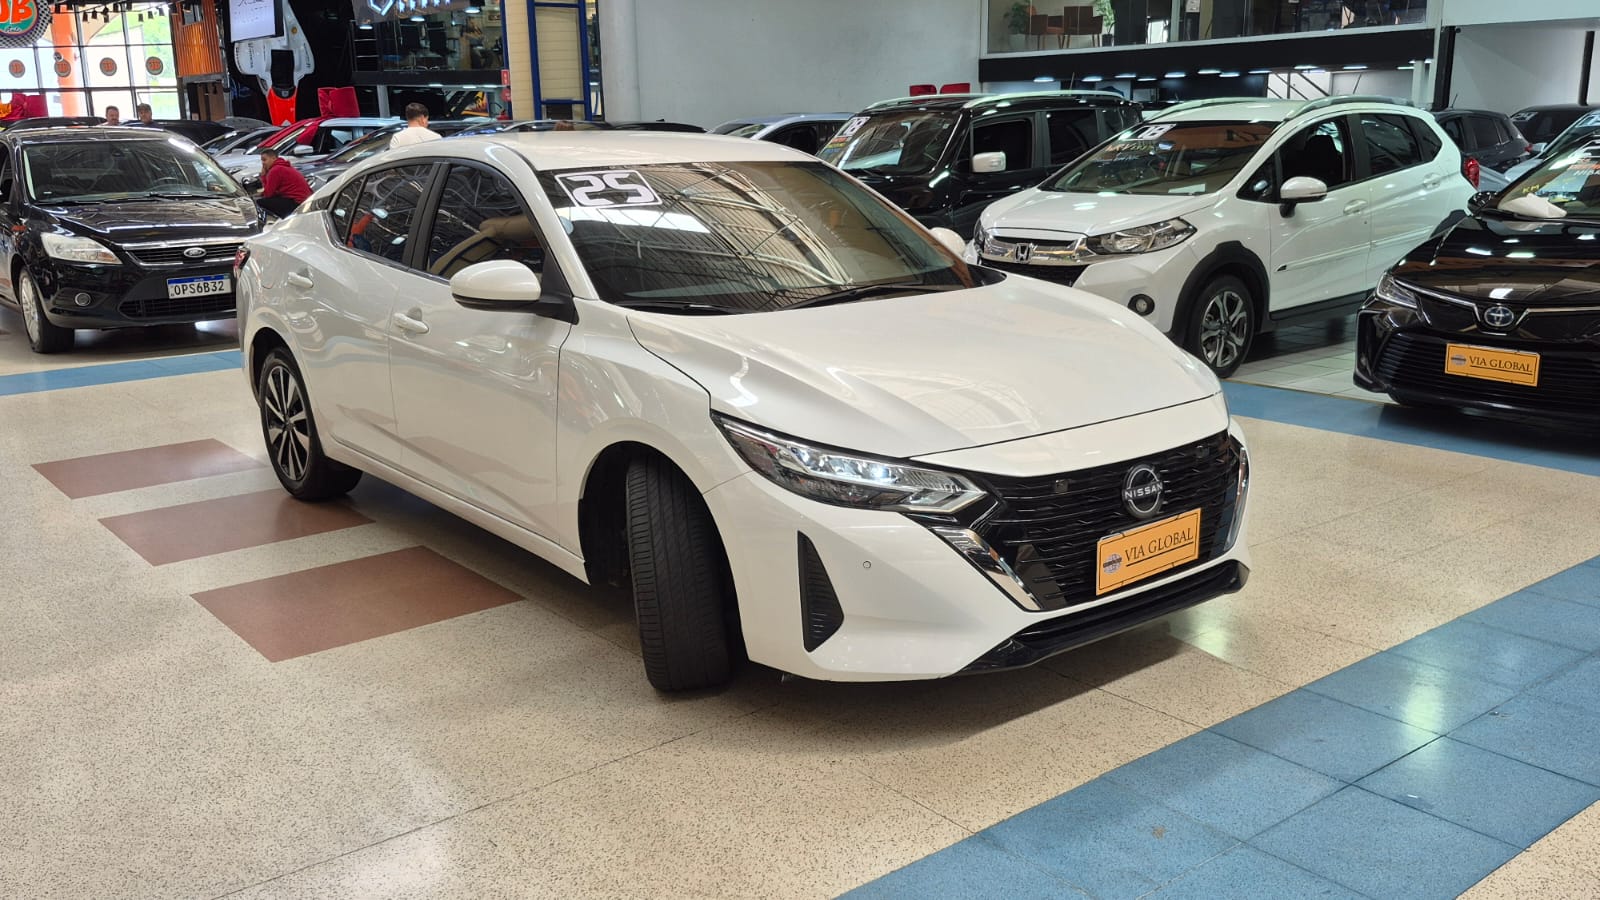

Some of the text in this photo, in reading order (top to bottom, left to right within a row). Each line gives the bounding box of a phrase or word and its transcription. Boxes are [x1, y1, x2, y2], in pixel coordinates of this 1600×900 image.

[566, 173, 655, 206] 25
[1469, 355, 1533, 373] VIA GLOBAL
[1124, 482, 1163, 500] NISSAN
[1124, 528, 1194, 562] VIA GLOBAL
